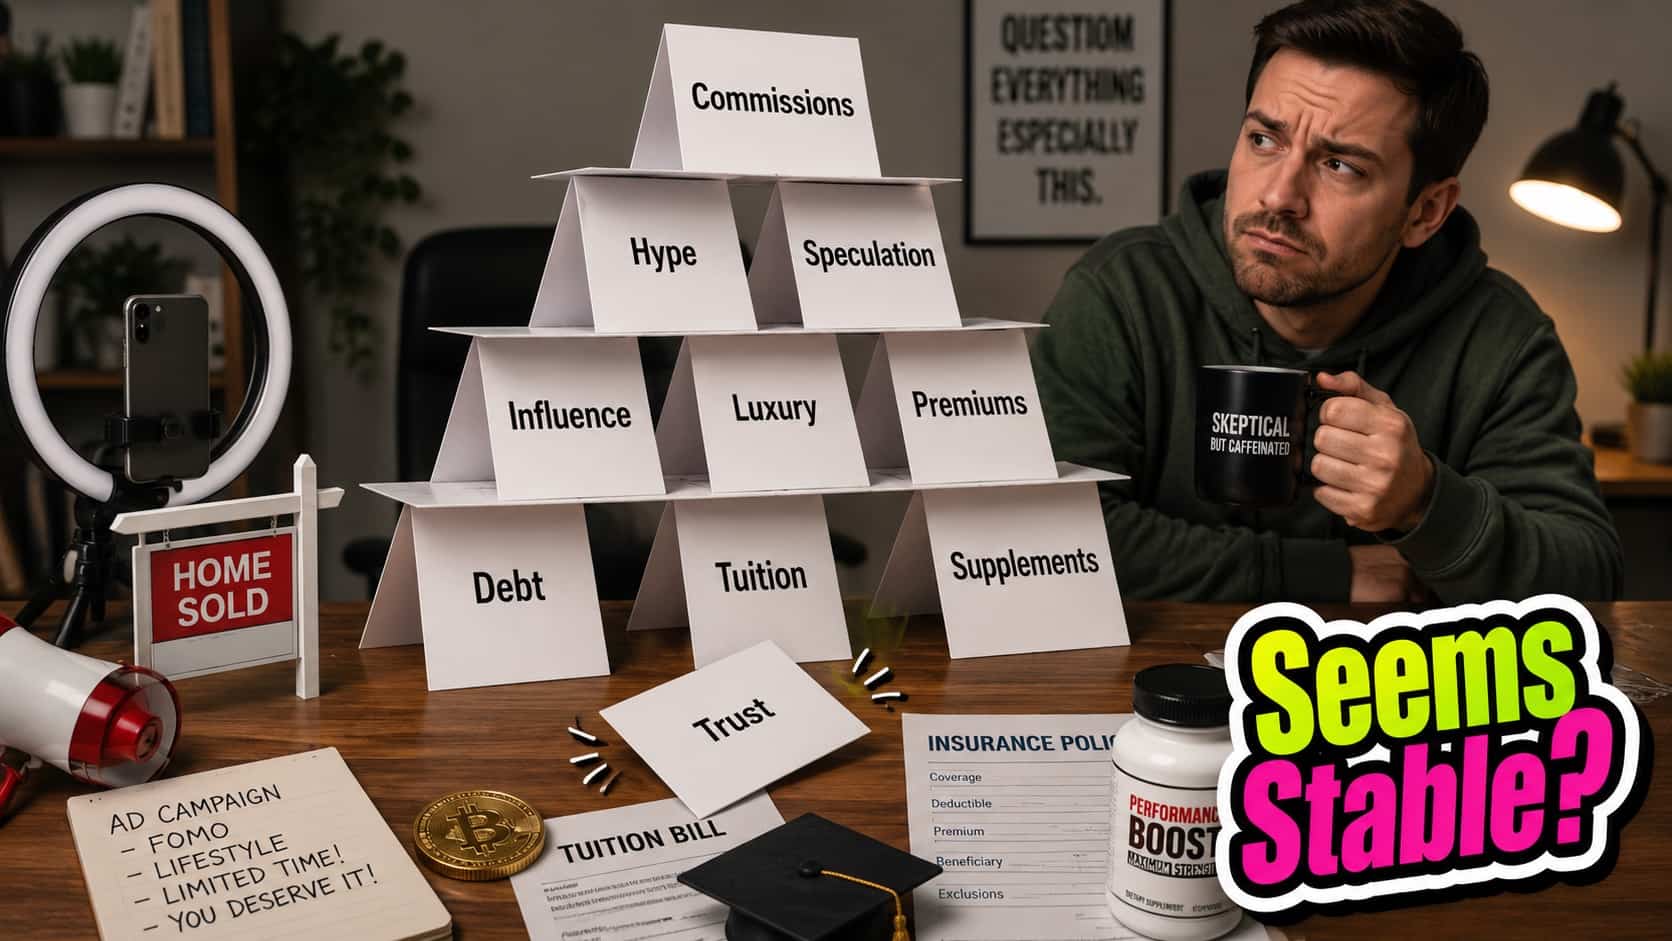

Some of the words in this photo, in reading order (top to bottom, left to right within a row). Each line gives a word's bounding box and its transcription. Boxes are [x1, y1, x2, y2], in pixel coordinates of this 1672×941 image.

[692, 82, 854, 117] Commissions
[992, 67, 1144, 103] EVERYTHING
[998, 119, 1138, 154] ESPECIALLY
[1036, 168, 1102, 205] THIS.
[630, 237, 696, 272] Hype
[804, 240, 935, 272] Speculation
[509, 400, 631, 430] Influence
[732, 394, 816, 426] Luxury
[912, 390, 1027, 417] Premiums
[1212, 412, 1290, 437] SKEPTICAL
[1210, 437, 1226, 451] BUT
[1229, 440, 1290, 456] CAFFEINATED
[173, 551, 272, 591] HOME
[715, 560, 807, 592] Tuition
[951, 548, 1099, 586] Supplements
[473, 569, 545, 604] Debt
[178, 588, 269, 627] SOLD
[692, 699, 776, 742] Trust
[929, 736, 1055, 751] INSURANCE
[930, 772, 982, 784] Coverage
[111, 812, 144, 834] AD
[159, 784, 281, 823] CAMPAIGN
[932, 799, 992, 808] Deductible
[149, 822, 229, 854] FOMO
[557, 830, 664, 863] TUITION
[668, 819, 727, 844] BILL
[934, 826, 984, 836] Premium
[1129, 815, 1222, 859] BOOST
[154, 834, 288, 879] LIFESTYLE
[936, 856, 1002, 869] Beneficiary
[1128, 851, 1171, 875] MAXIMUM
[163, 866, 265, 905] LIMITED
[274, 844, 344, 876] TIME!
[168, 910, 216, 933] YOU
[227, 877, 334, 919] DESERVE
[343, 863, 378, 890] IT!
[938, 888, 1004, 901] Exclusions
